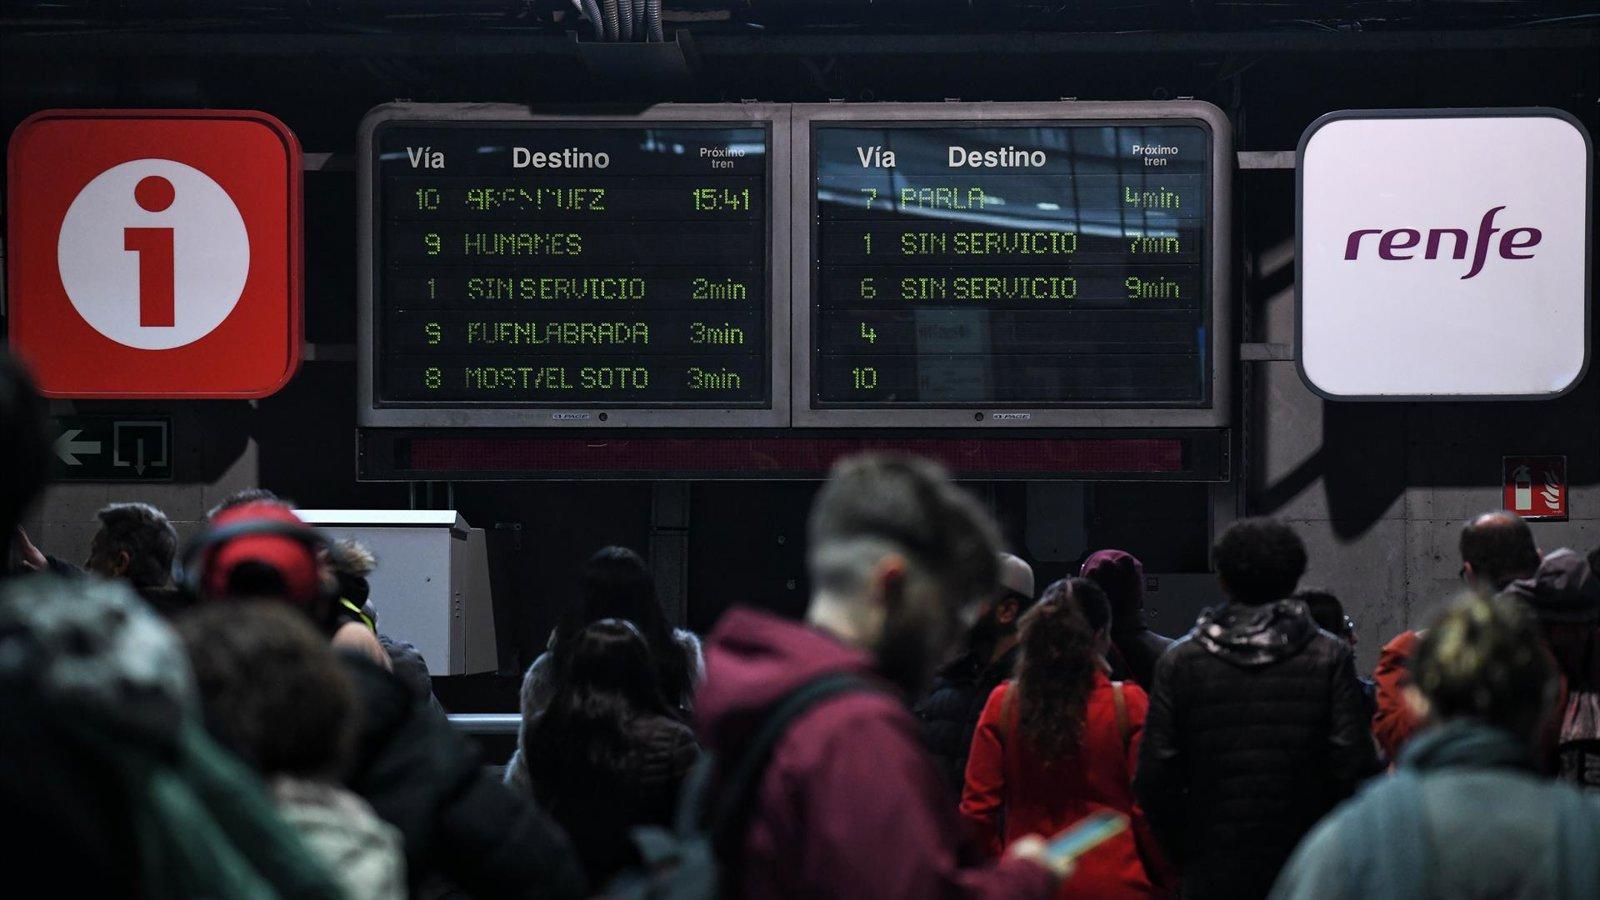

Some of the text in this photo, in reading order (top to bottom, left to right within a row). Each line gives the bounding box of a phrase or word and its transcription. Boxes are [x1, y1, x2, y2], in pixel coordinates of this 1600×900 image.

[406, 146, 610, 169] Vía Destino
[700, 147, 745, 158] Próximo
[857, 146, 1047, 168] Vía Destino
[1132, 145, 1179, 156] Próximo
[712, 159, 734, 169] tren
[1144, 156, 1168, 167] tren
[416, 189, 440, 210] 10
[693, 189, 749, 210] 15:41
[861, 187, 1180, 210] 7 PARLA 4min
[425, 234, 582, 255] 9 HUMANES
[863, 232, 1180, 254] 1 SIN SERVICIO 7min
[1344, 205, 1543, 280] renfe
[428, 278, 746, 299] 1 SIN SERVICIO 2min
[861, 277, 1180, 299] 6 SIN SERVICIO 9min
[468, 323, 649, 344] FUENLABRADA
[690, 323, 744, 344] 3min
[861, 322, 877, 344] 4
[425, 368, 441, 388] 8
[580, 368, 649, 388] SOTO
[687, 368, 741, 388] 3min
[852, 367, 877, 389] 10
